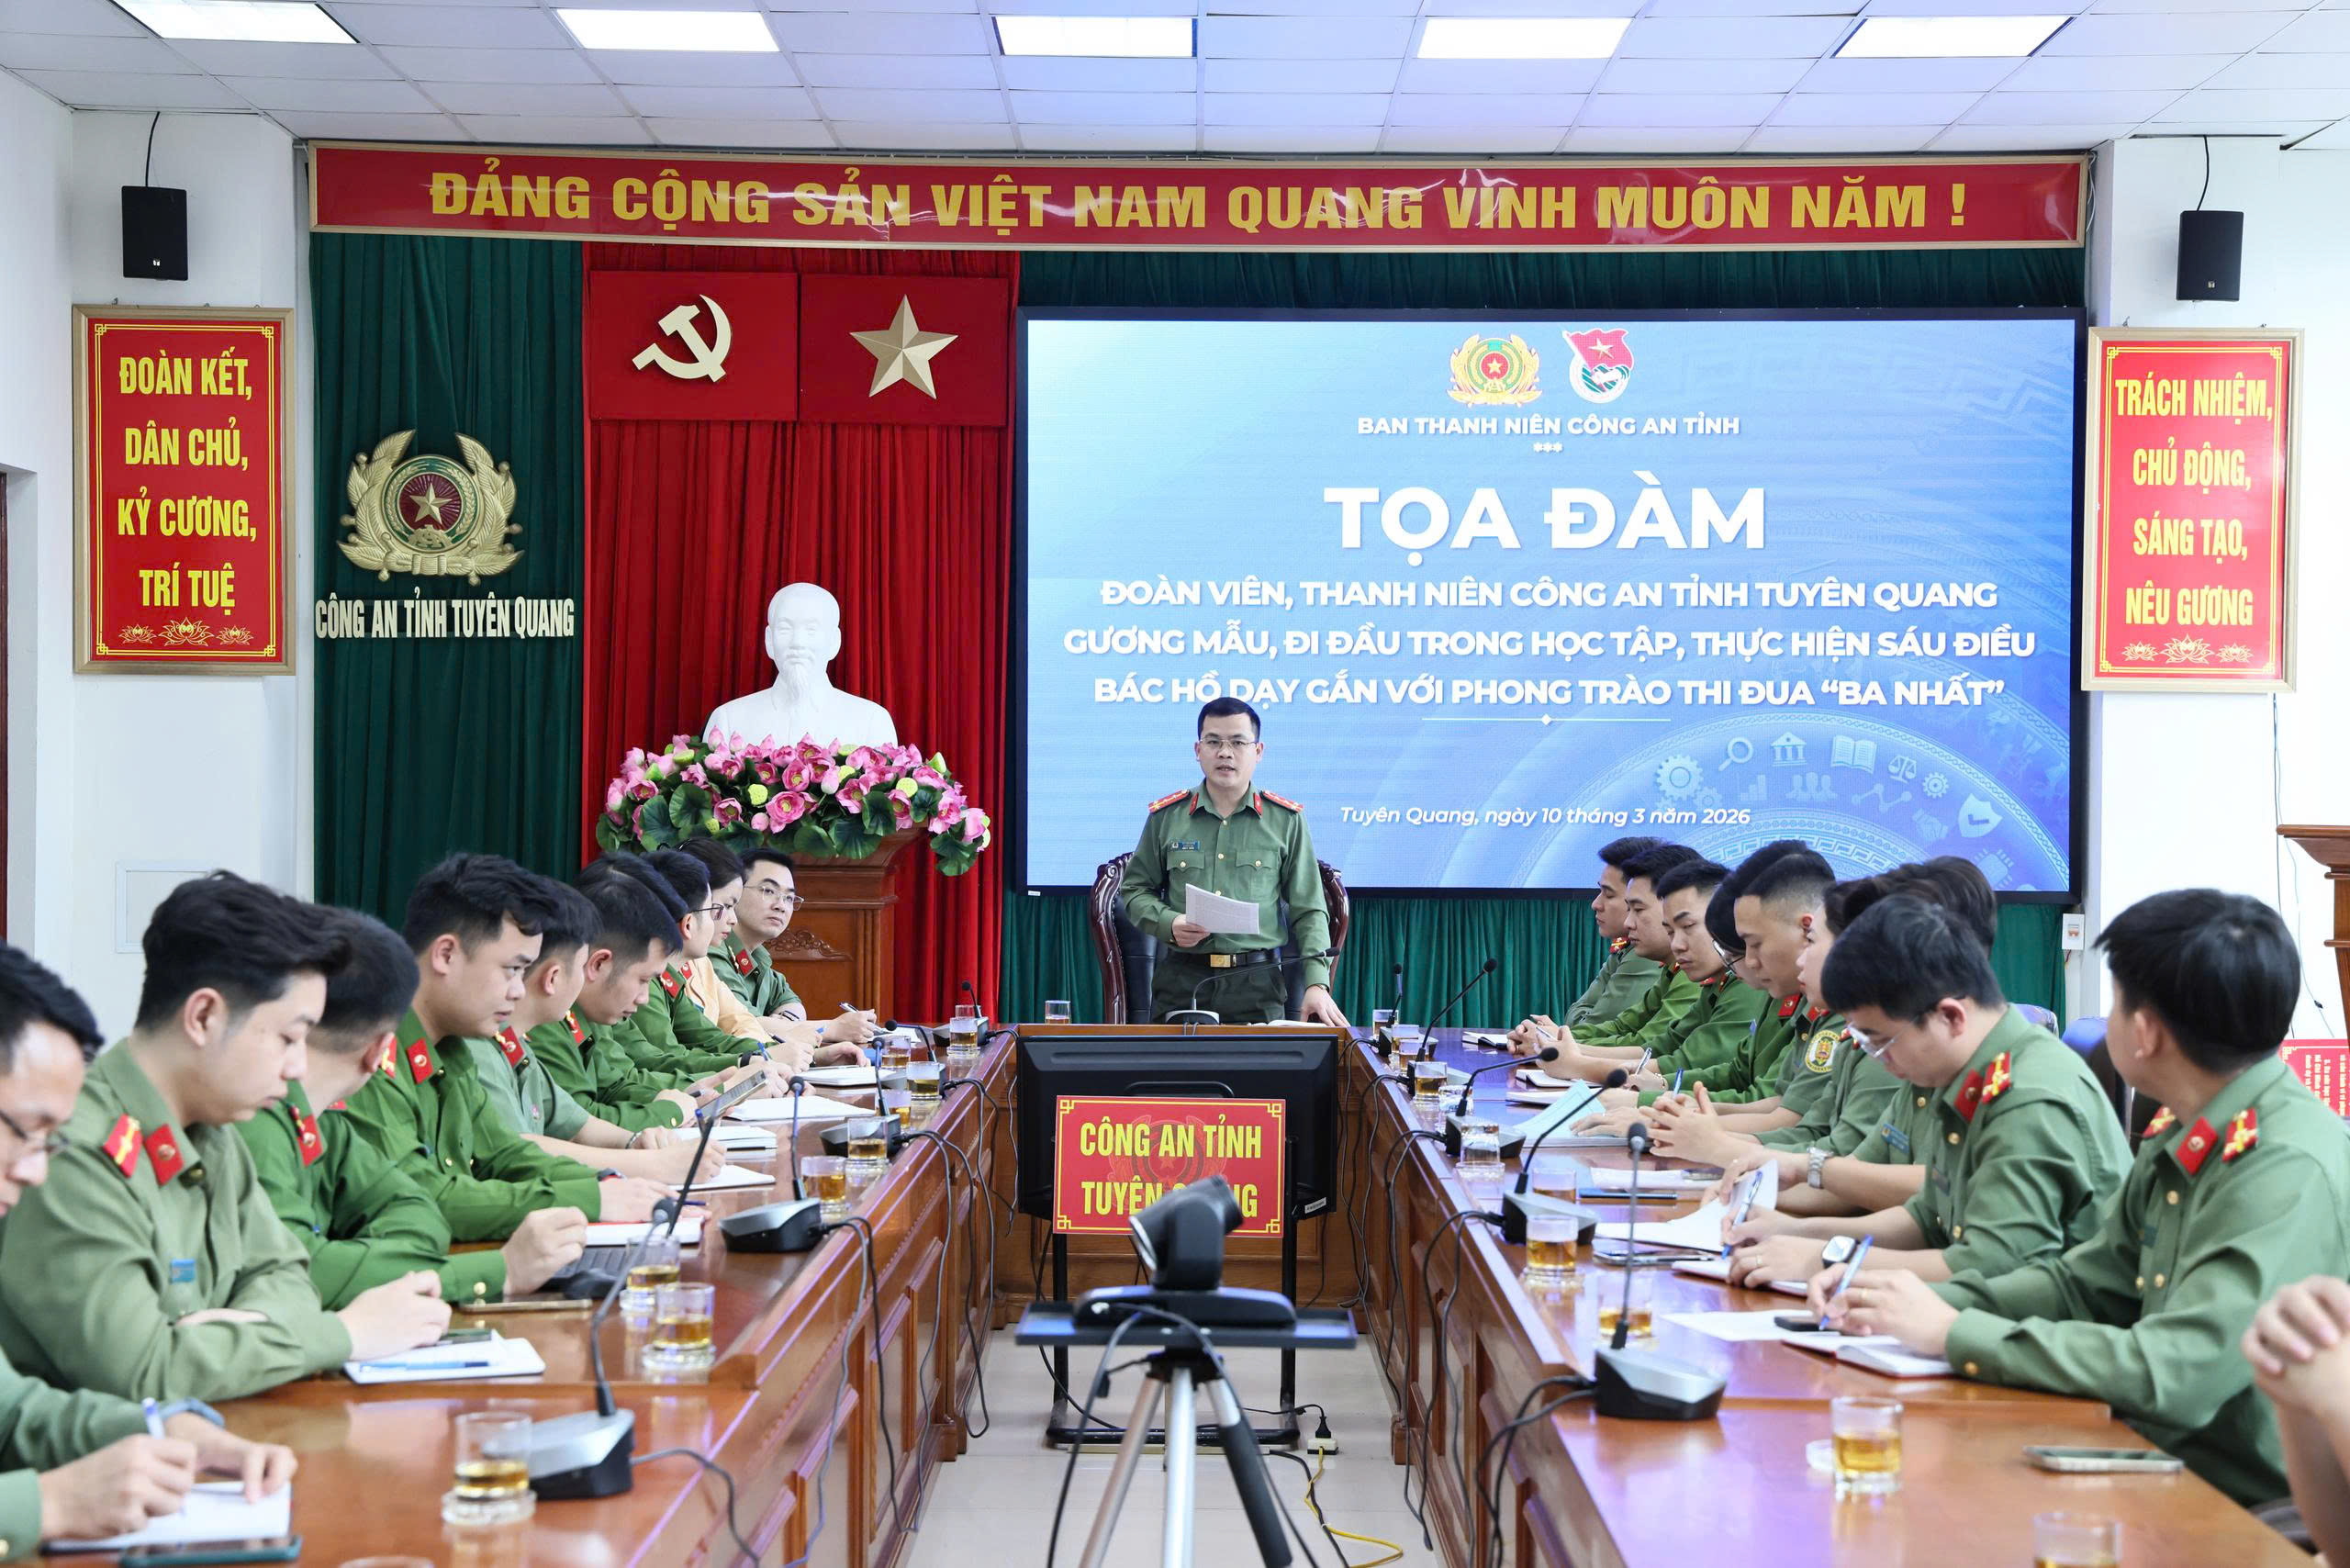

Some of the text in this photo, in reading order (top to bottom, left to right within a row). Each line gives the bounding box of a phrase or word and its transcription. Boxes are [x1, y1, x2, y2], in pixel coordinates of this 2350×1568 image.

[431, 158, 1964, 235] ĐẢNG CỘNG SẢN VIỆT NAM QUANG VINH MUÔN NĂM !
[119, 347, 252, 400] ĐOÀN KẾT,
[2115, 372, 2274, 425] TRÁCH NHIỆM,
[126, 417, 248, 470] DÂN CHỦ,
[1359, 411, 1739, 434] BAN THANH NIÊN CÔNG AN TỈNH
[2132, 436, 2251, 493] CHỦ ĐỘNG,
[118, 487, 256, 542] KỶ CƯƠNG,
[1324, 470, 1763, 566] TỌA ĐÀM
[2133, 510, 2247, 563] SÁNG TẠO,
[140, 562, 235, 615] TRÍ TUỆ
[316, 587, 574, 639] CÔNG AN TỈNH TUYÊN QUANG
[1101, 574, 1997, 611] ĐOÀN VIÊN, THANH NIÊN CÔNG AN TỈNH TUYÊN QUANG
[2125, 580, 2254, 625] NÊU GƯƠNG
[1064, 620, 2034, 662] GƯƠNG MẪU, ĐI ĐẦU TRONG HỌC TẬP, THỰC HIỆN SÁU ĐIỀU
[1095, 669, 2004, 709] BÁC HỒ DẠY GẮN VỚI PHONG TRÀO THI ĐUA “BA NHẤT”
[1341, 807, 1750, 826] Tuyên Quang, ngày 10 tháng 3 năm 2026
[1080, 1114, 1261, 1158] CÔNG AN TỈNH
